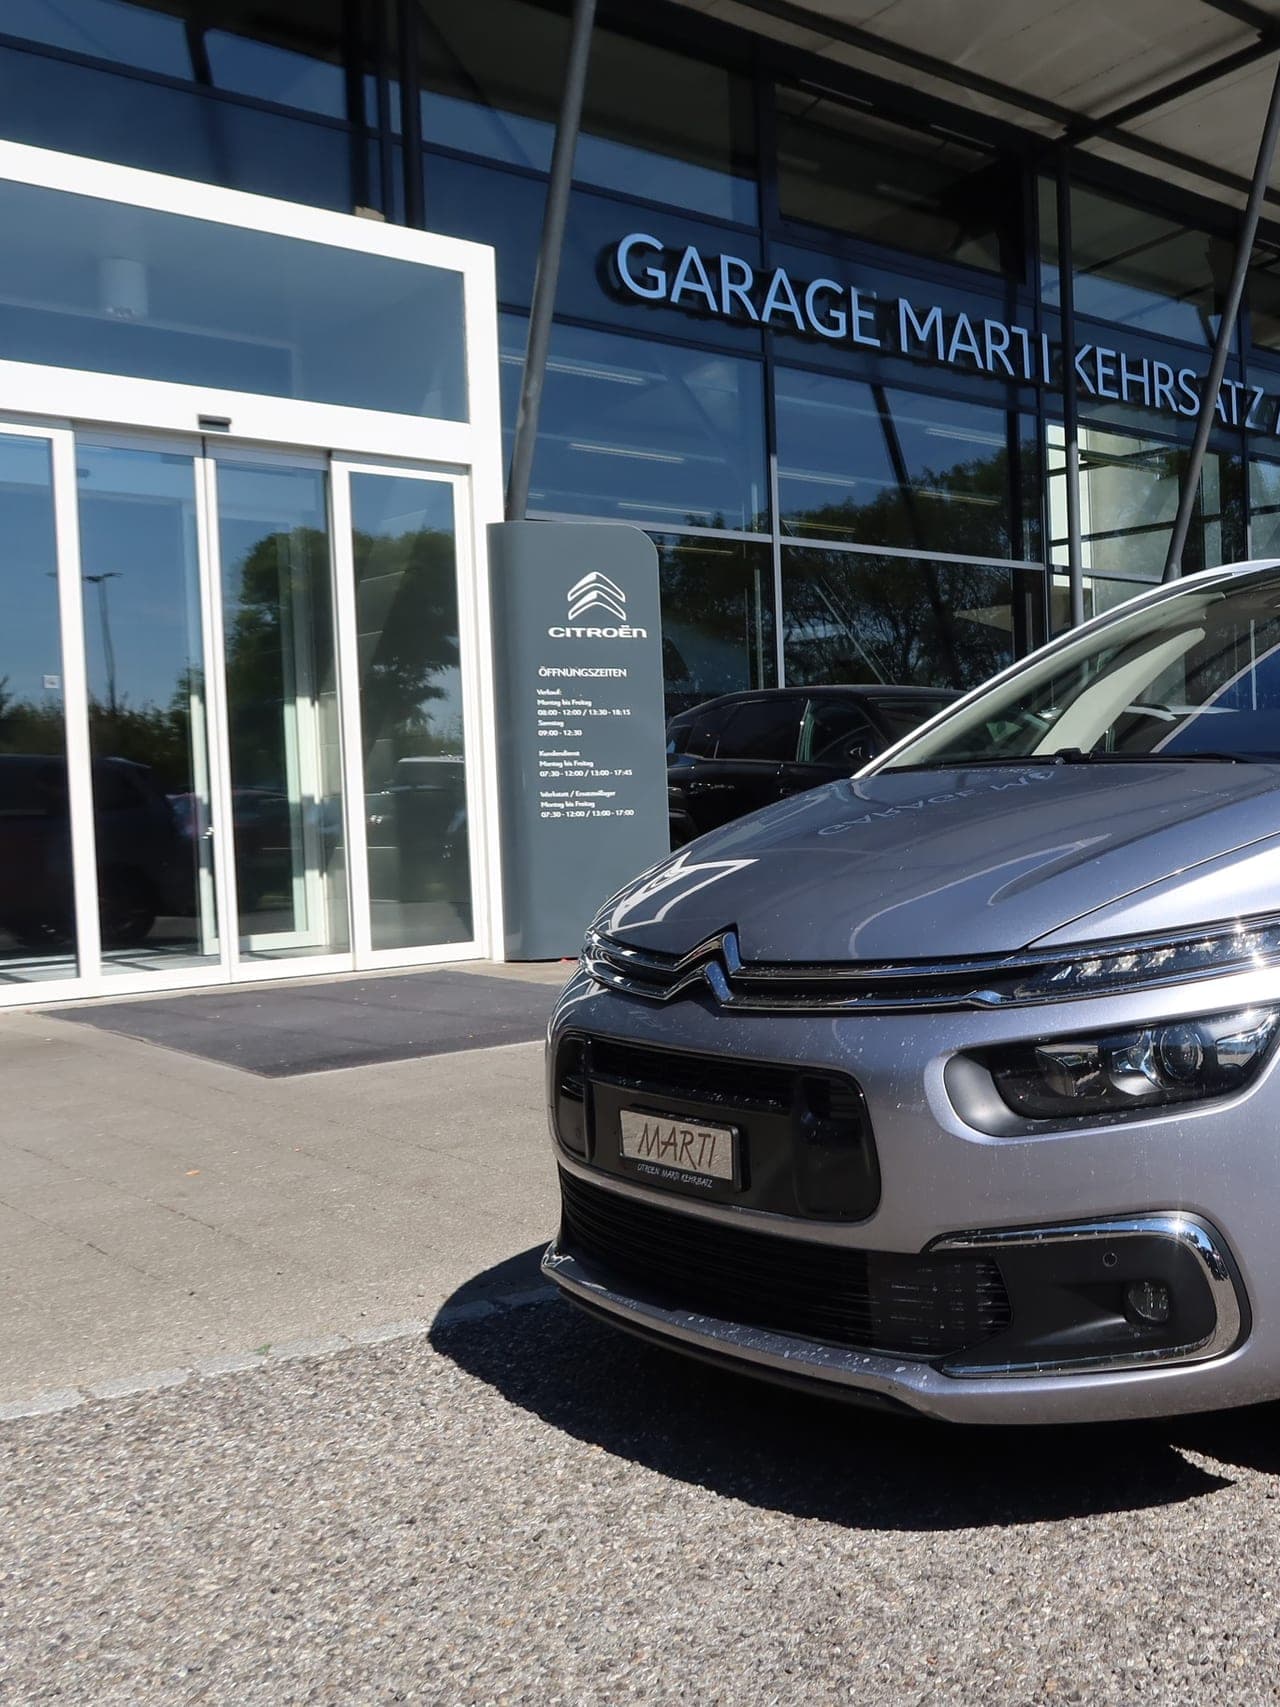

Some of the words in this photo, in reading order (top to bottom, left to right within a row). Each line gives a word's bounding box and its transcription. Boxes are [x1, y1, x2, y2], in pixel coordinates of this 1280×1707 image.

[617, 233, 881, 347] GARAGE
[899, 297, 1050, 384] MARTI
[538, 666, 627, 677] ÖFFNUNGSZEITEN
[637, 1122, 717, 1170] MARTI
